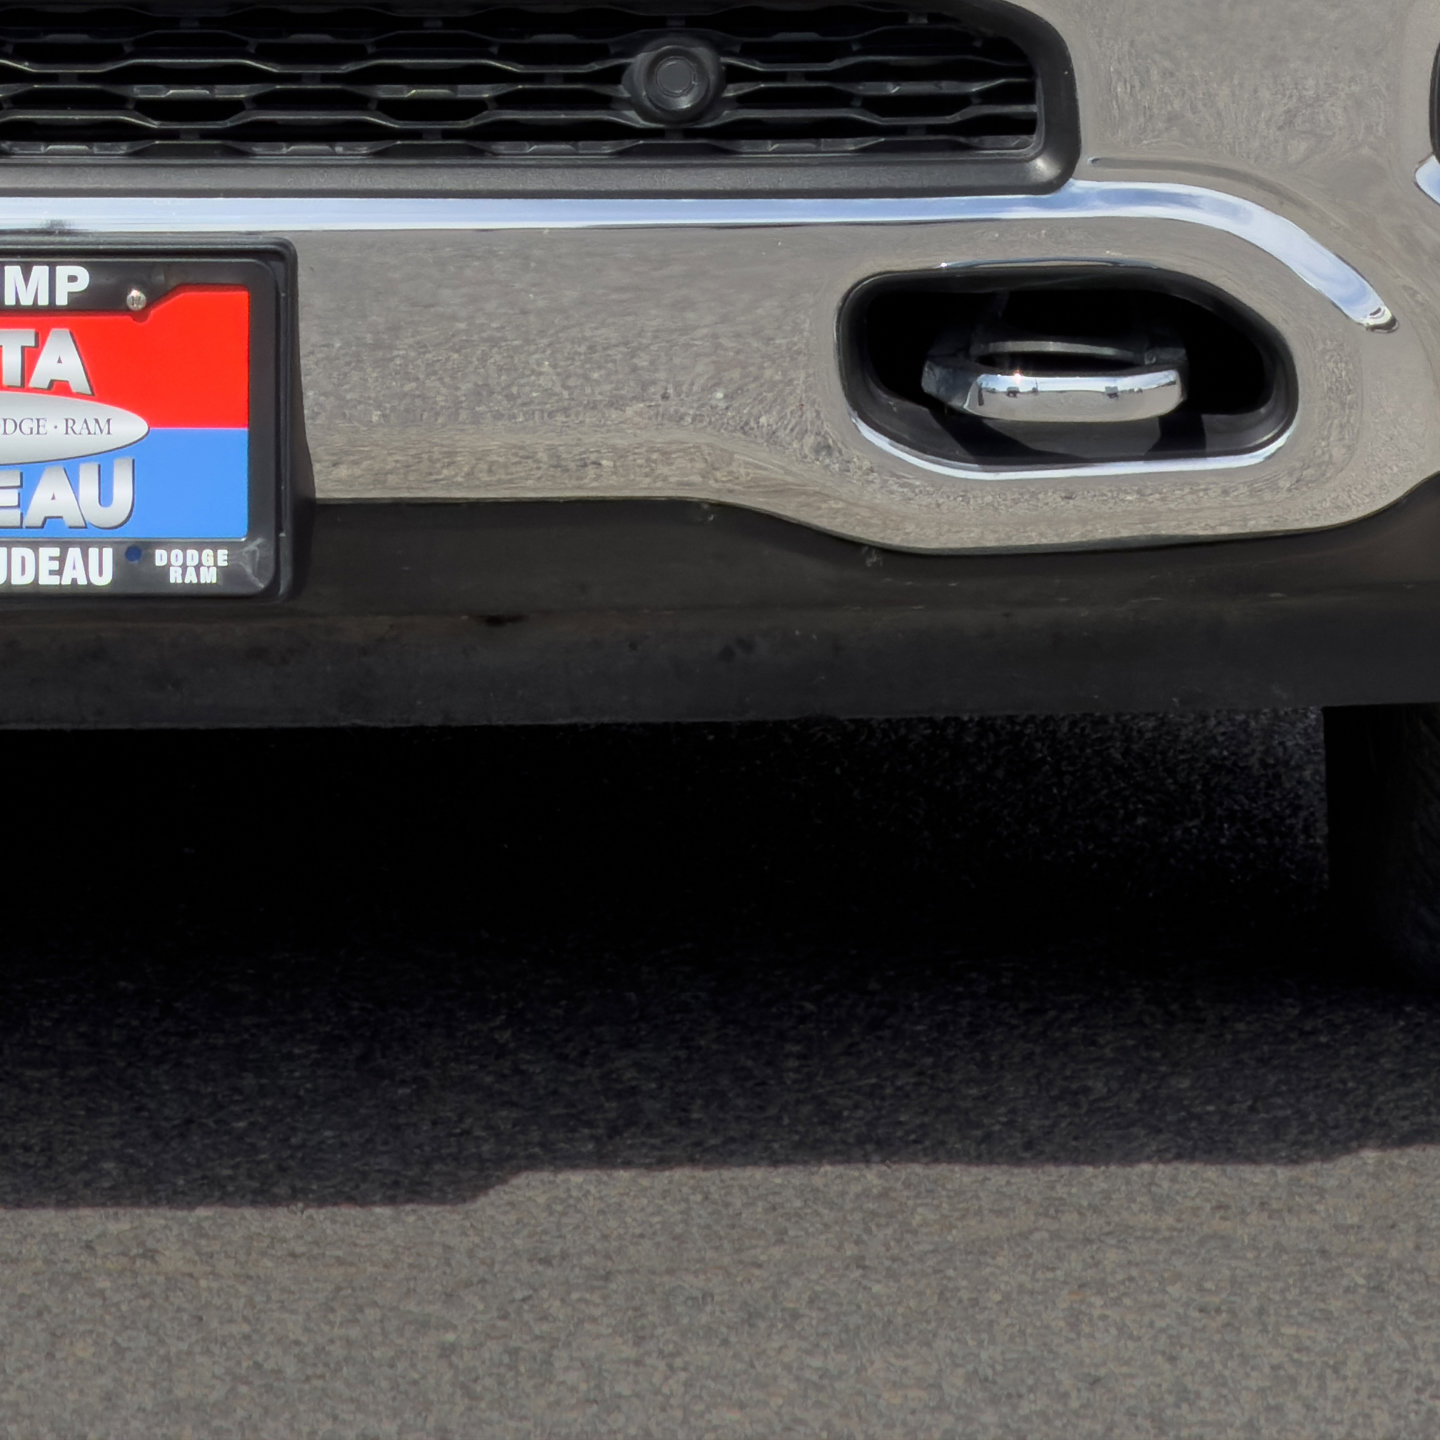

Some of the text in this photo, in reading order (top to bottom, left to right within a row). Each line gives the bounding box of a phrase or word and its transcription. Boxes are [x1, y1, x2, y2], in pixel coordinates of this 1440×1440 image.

[63, 416, 113, 436] RAM
[154, 548, 229, 567] DODGE
[168, 566, 218, 584] RAM
